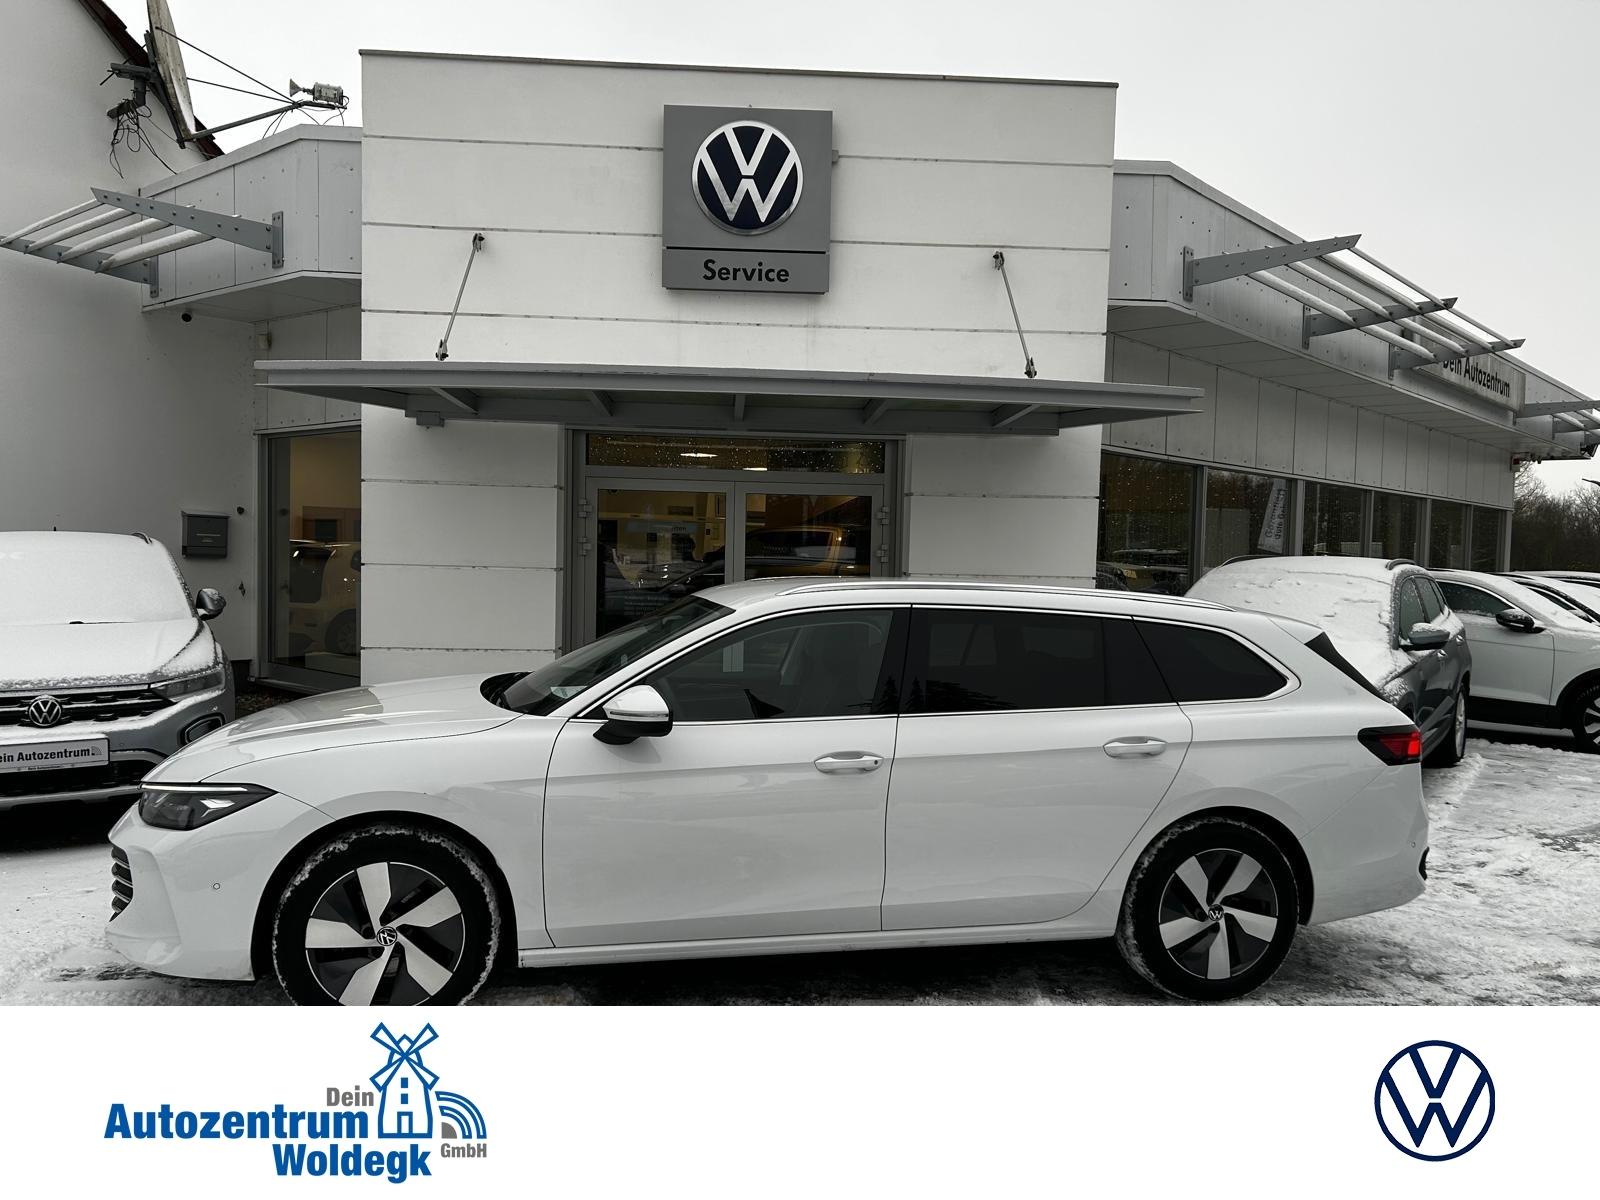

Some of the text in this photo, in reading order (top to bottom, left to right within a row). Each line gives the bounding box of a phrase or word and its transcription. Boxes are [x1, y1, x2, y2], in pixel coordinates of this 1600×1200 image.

[692, 120, 803, 236] VW
[703, 258, 790, 283] Service
[1464, 357, 1510, 397] Autozentrum
[29, 695, 61, 726] VW
[17, 749, 90, 761] Autozentrum
